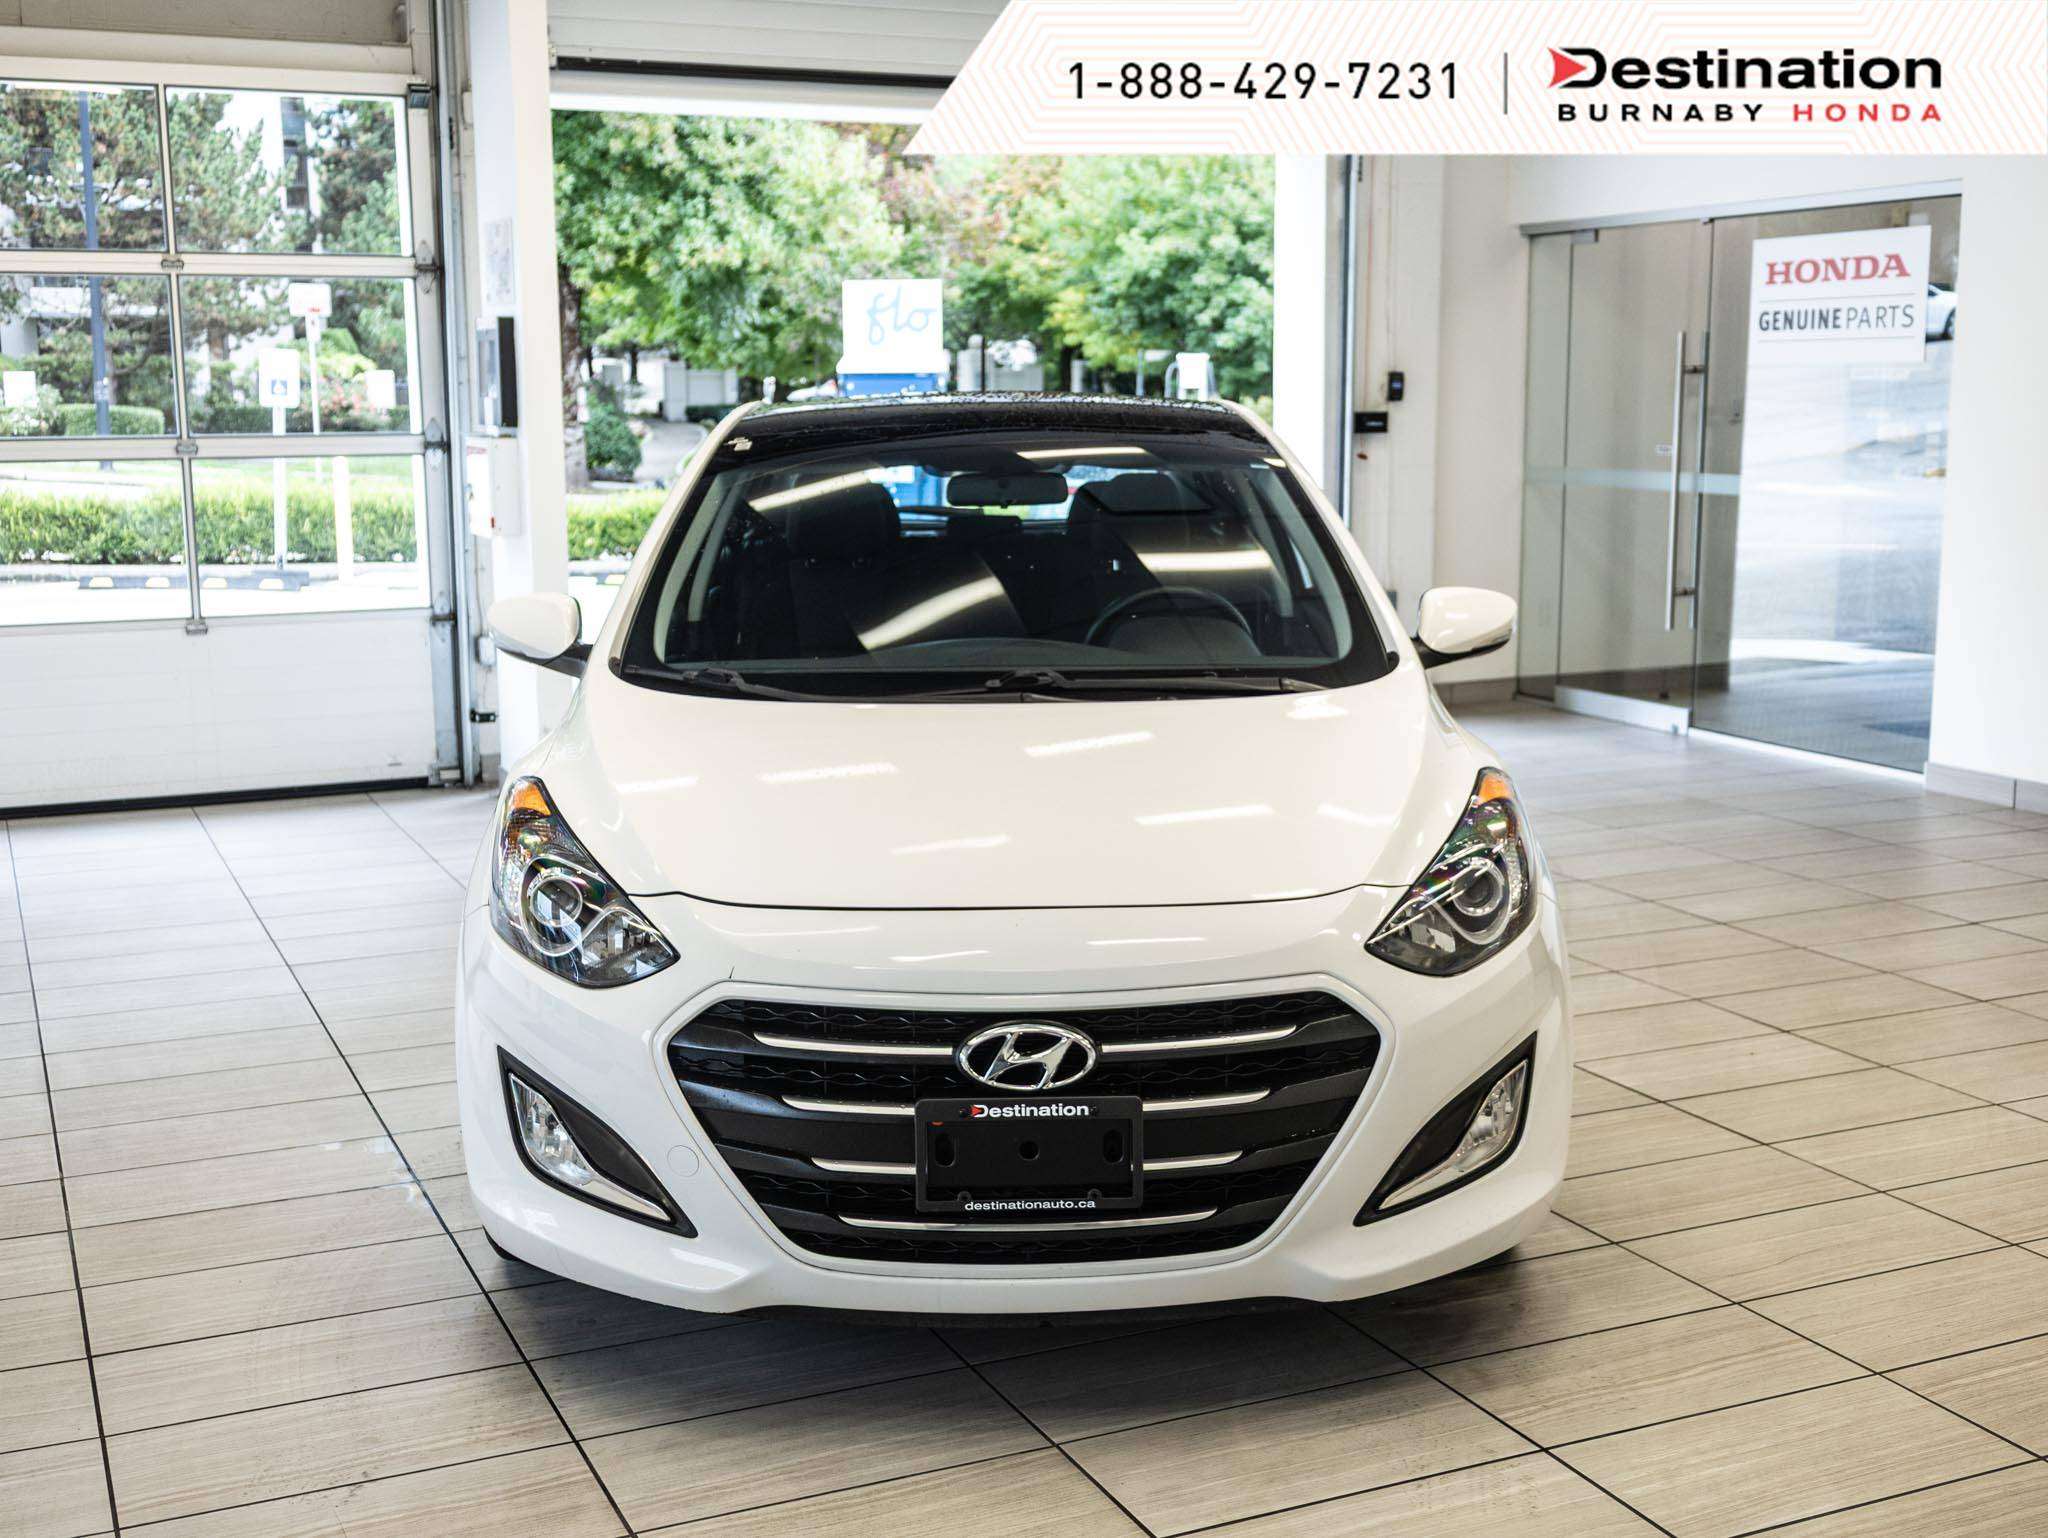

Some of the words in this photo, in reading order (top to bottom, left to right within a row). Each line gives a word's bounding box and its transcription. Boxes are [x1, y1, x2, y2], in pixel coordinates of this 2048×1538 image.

[1765, 253, 1911, 285] HONDA
[971, 1103, 1090, 1118] Destination
[964, 1199, 1096, 1212] destinationauto.ca
